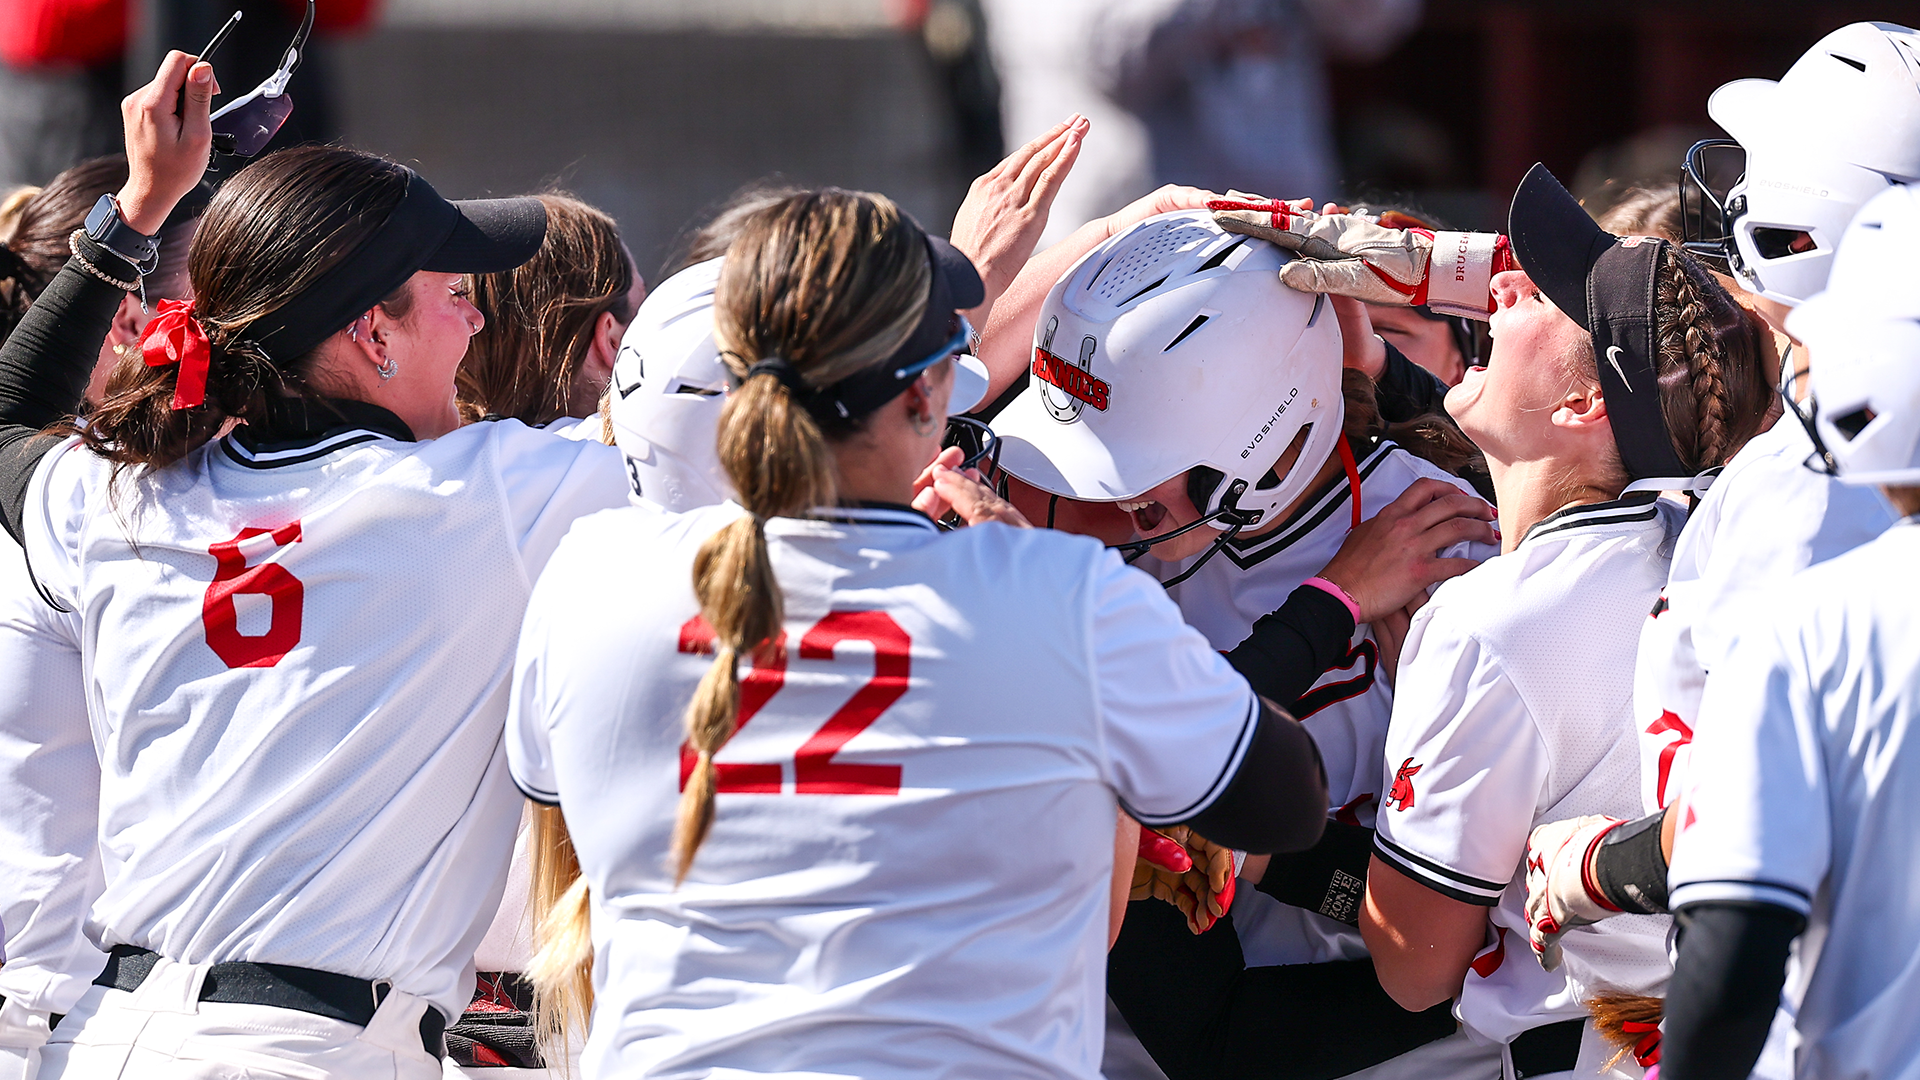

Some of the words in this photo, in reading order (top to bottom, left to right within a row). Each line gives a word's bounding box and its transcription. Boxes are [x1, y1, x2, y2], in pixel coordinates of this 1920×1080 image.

[1759, 179, 1829, 198] EVOSHIELD
[1032, 346, 1110, 412] JENNIES
[1240, 387, 1299, 459] EVOSHIELD
[203, 520, 304, 668] 6
[678, 609, 912, 796] 22
[1328, 875, 1353, 918] ZONE
